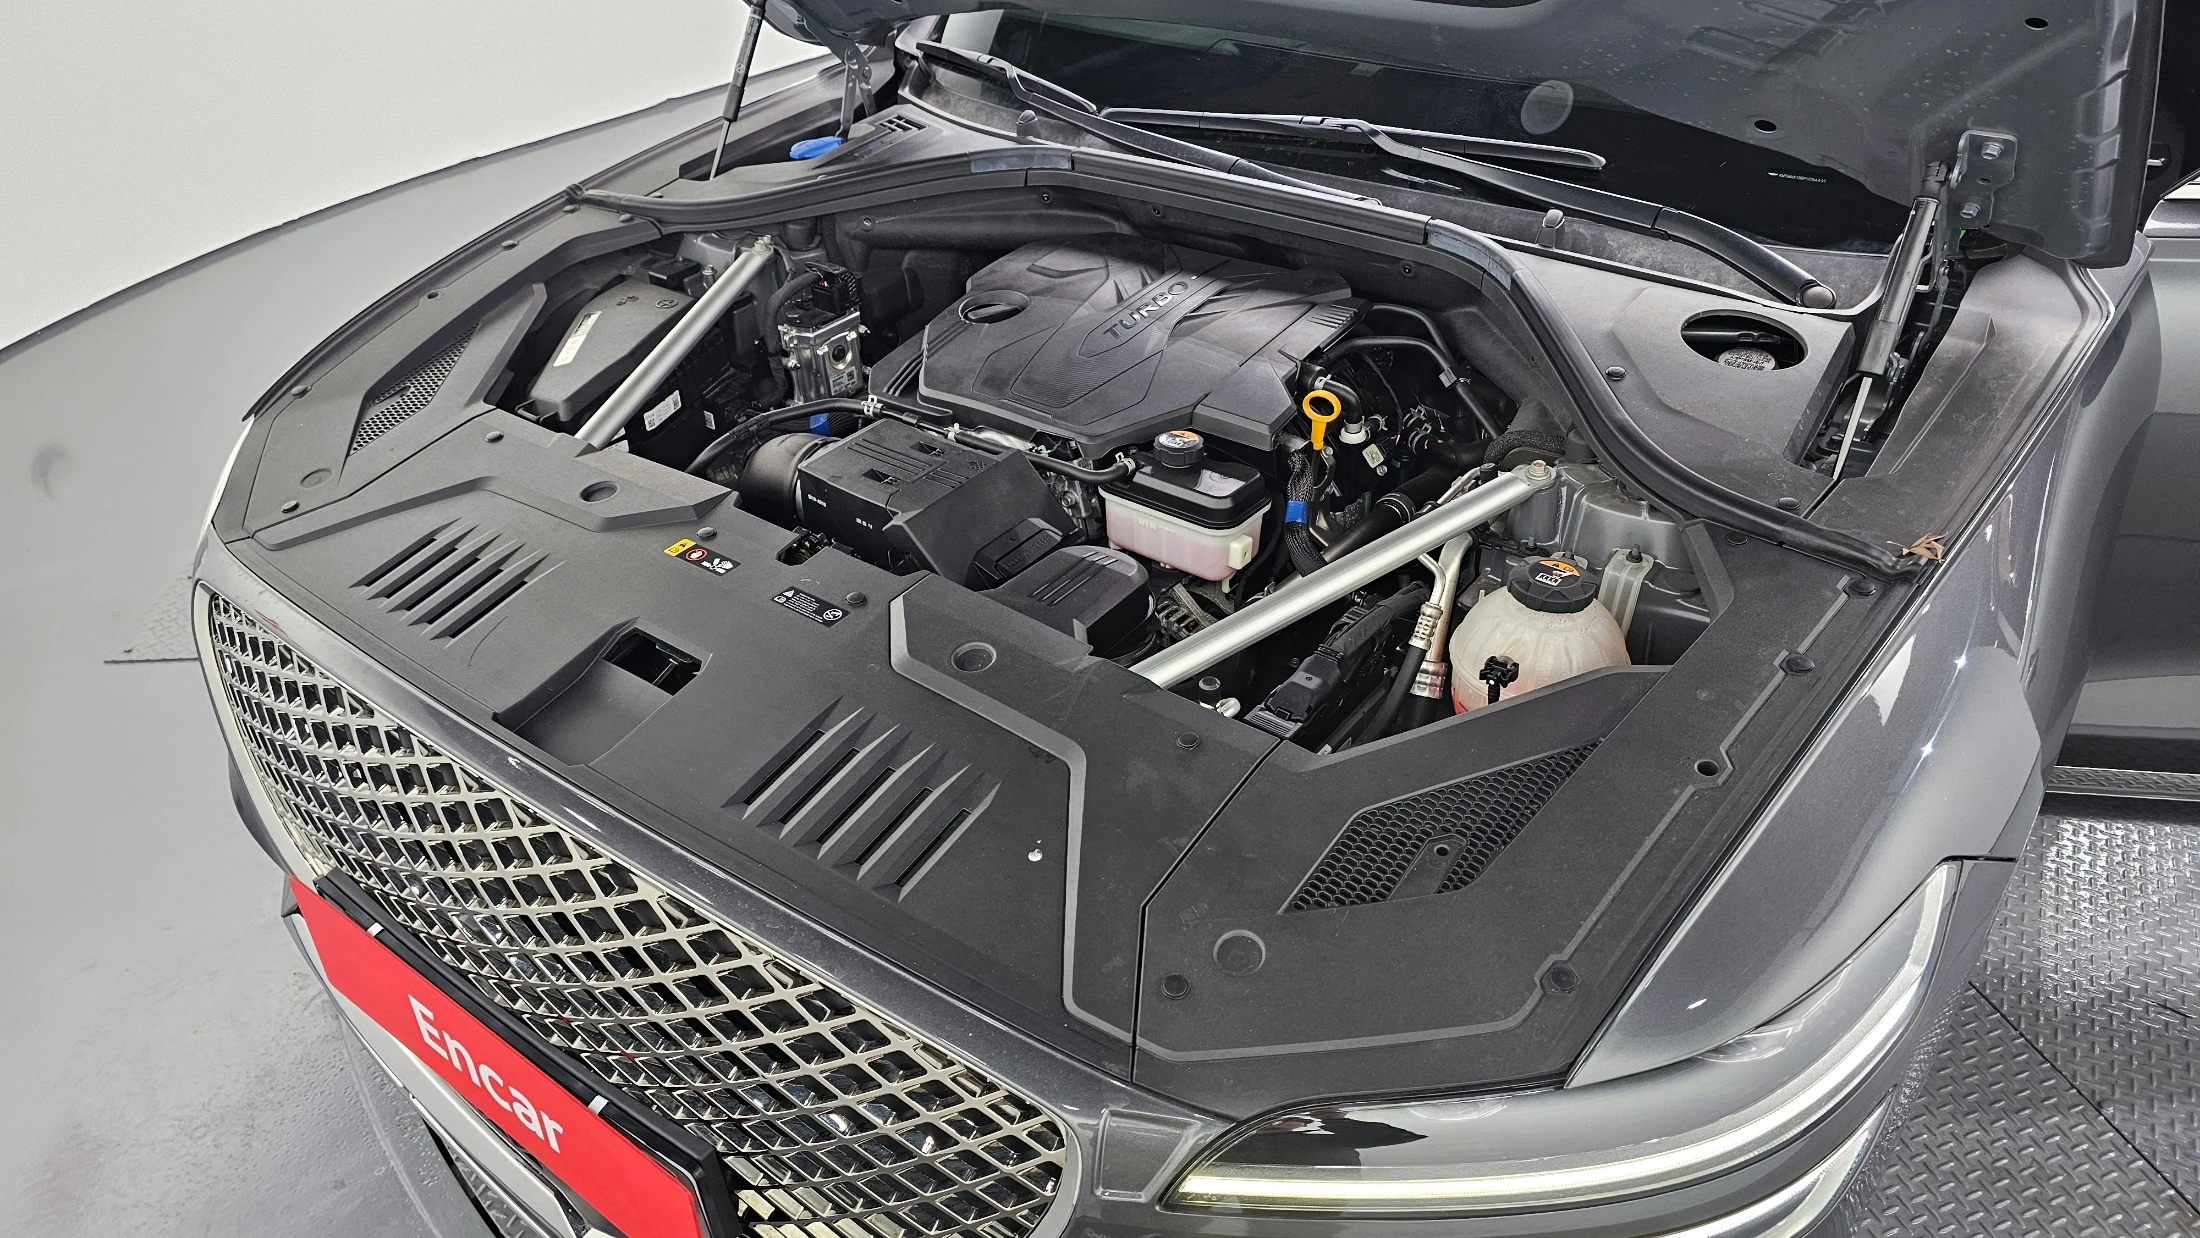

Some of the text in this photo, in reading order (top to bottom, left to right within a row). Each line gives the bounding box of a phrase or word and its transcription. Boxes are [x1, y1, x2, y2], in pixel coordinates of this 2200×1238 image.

[1102, 281, 1188, 339] TURBO
[1138, 517, 1157, 531] MIN
[407, 994, 565, 1154] Encar
